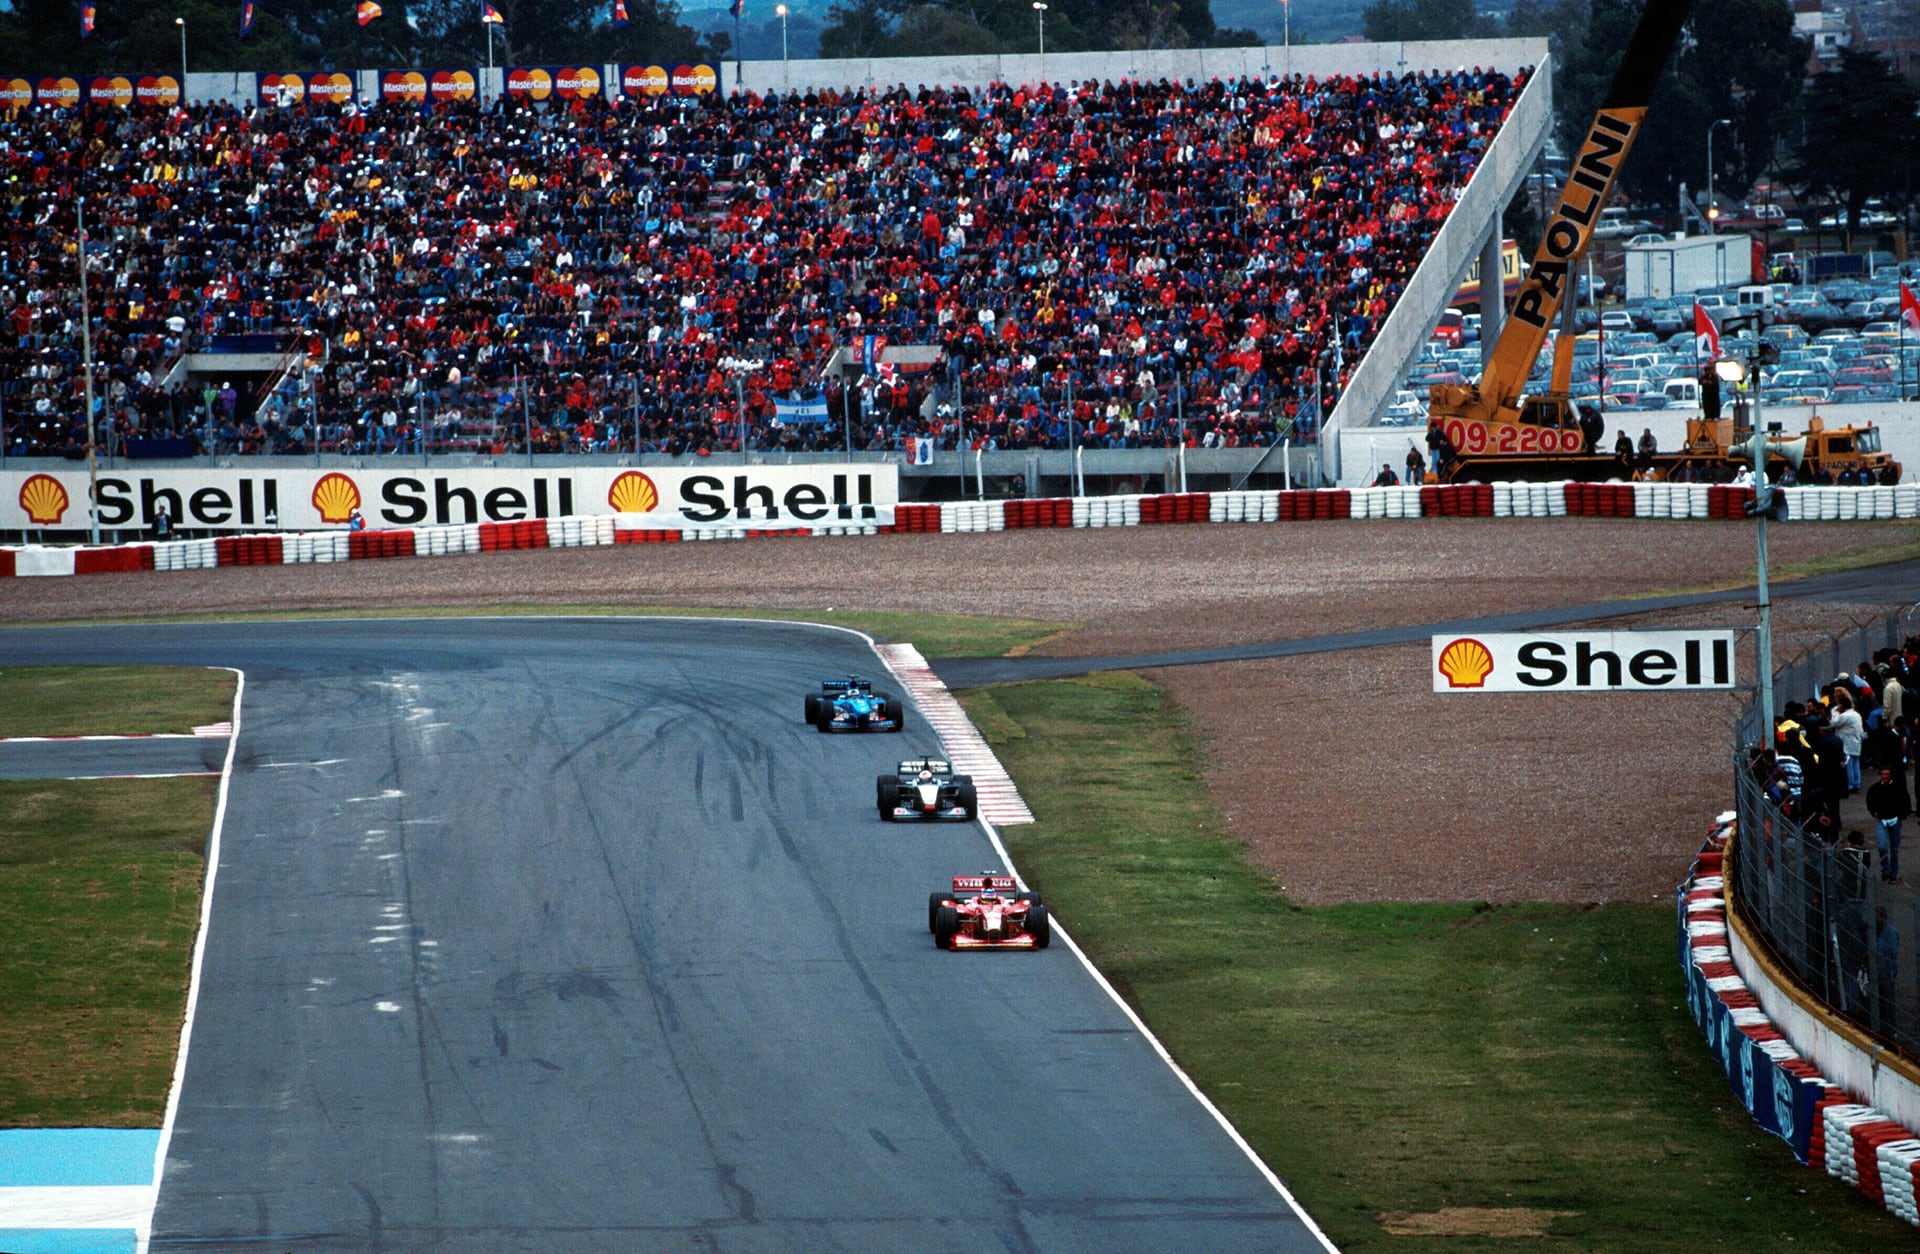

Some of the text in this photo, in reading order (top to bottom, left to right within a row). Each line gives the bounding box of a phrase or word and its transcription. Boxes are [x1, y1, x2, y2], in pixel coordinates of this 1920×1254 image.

[508, 79, 552, 90] MasterCard
[556, 78, 600, 89] MasterCard
[624, 76, 668, 87] MasterCard
[672, 75, 716, 86] MasterCard
[90, 87, 133, 97] MasterCard
[137, 86, 180, 96] MasterCard
[309, 84, 352, 94] MasterCard
[383, 82, 427, 93] MasterCard
[431, 81, 475, 92] MasterCard
[37, 89, 80, 98] MasterCard
[1513, 114, 1632, 329] PAOLINI
[88, 478, 277, 524] Shell
[380, 477, 574, 524] Shell
[679, 474, 876, 521] Shell
[1516, 639, 1729, 686] Shell
